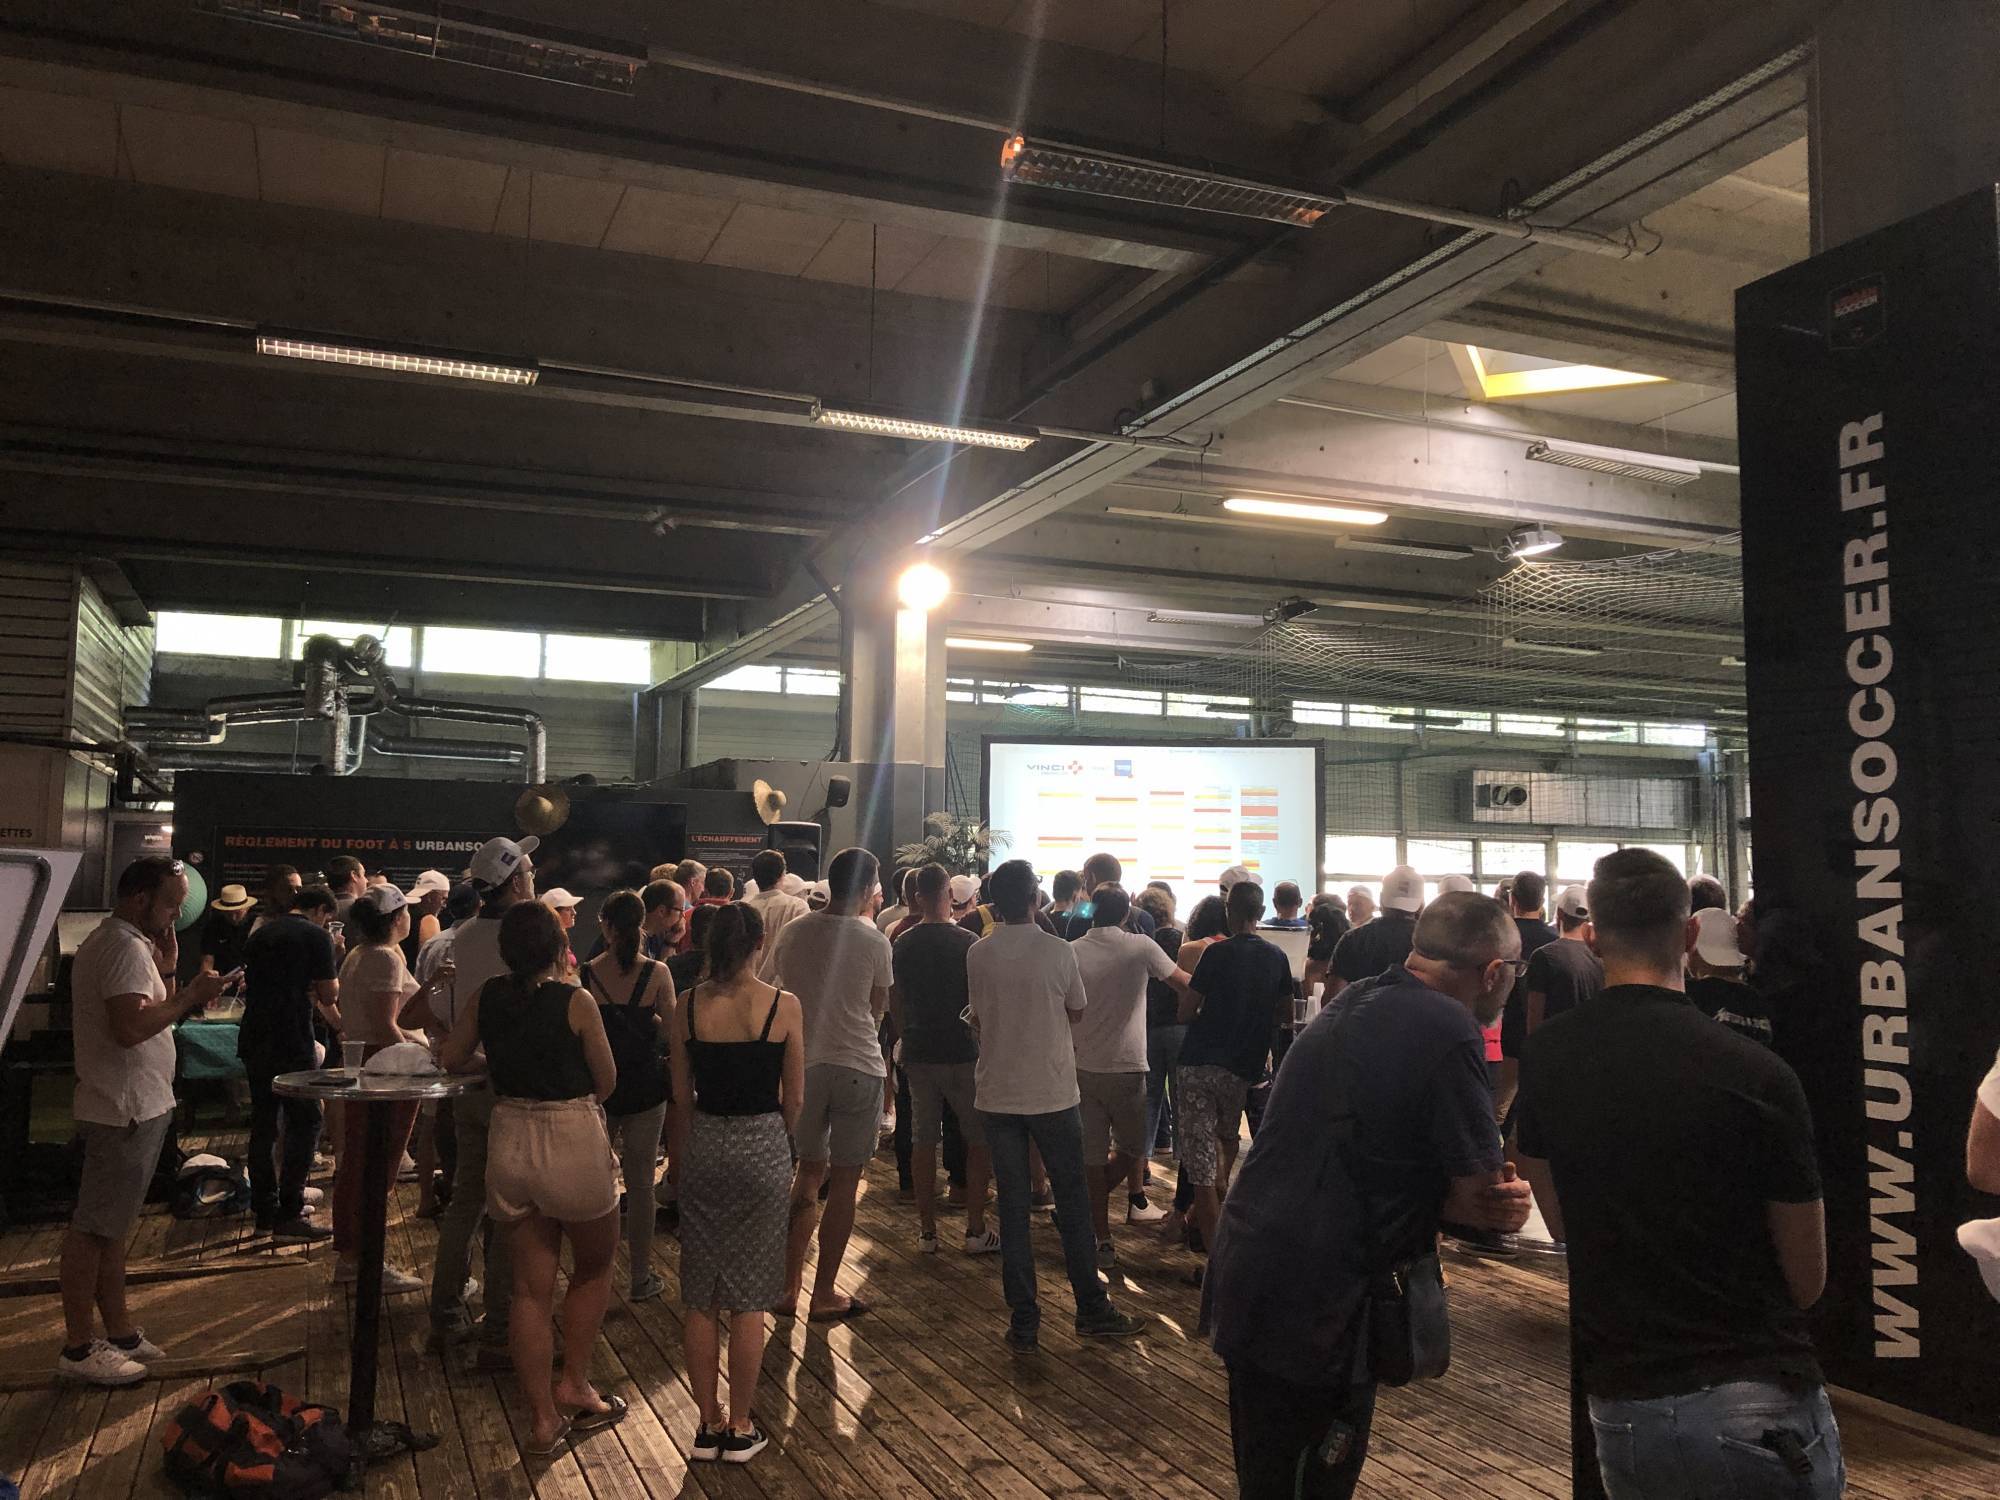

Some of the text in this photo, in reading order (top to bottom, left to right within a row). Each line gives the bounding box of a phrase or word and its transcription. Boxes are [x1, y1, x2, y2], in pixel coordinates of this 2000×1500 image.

[320, 837, 342, 849] DU
[346, 838, 385, 850] FOOT
[1839, 411, 1920, 1359] WWW.URBANSOCCER.FR
